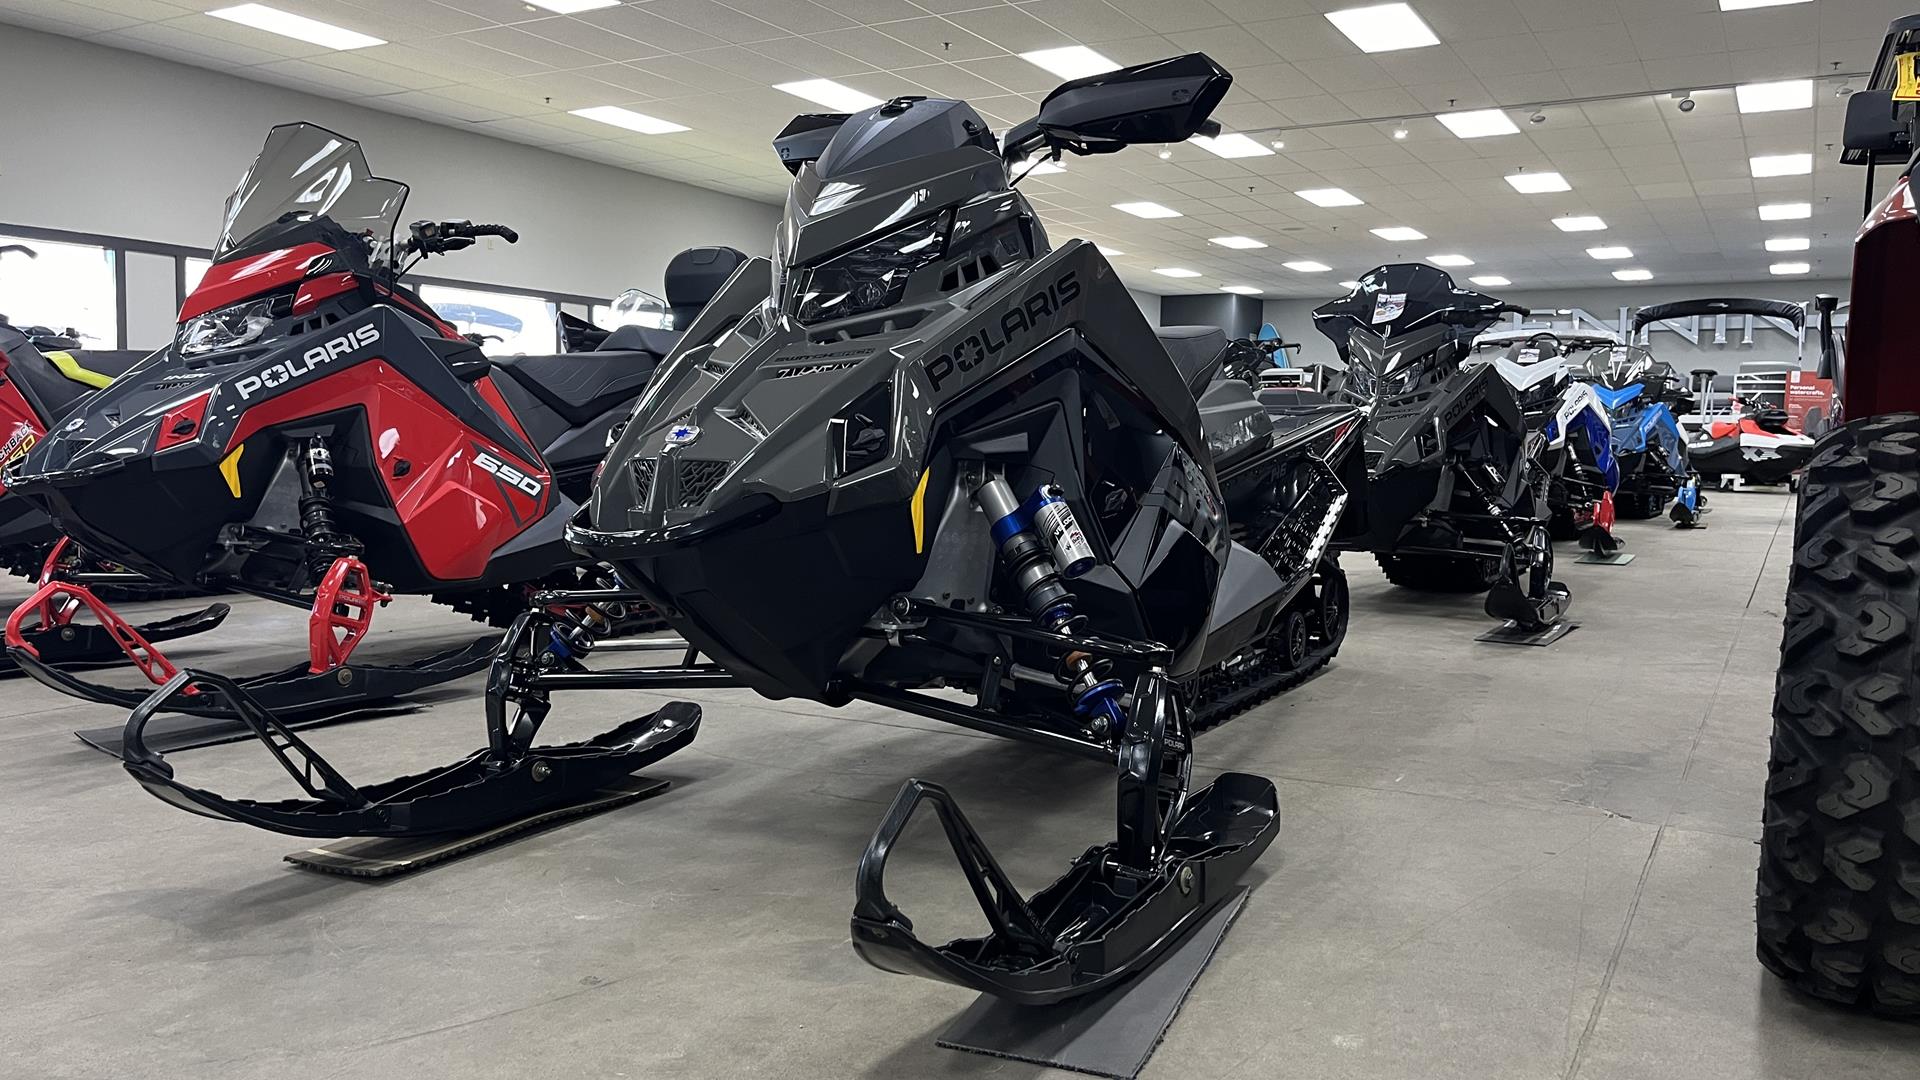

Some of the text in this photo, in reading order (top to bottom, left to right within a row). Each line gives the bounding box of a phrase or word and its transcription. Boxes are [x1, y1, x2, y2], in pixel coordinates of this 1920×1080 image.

[924, 270, 1081, 393] POLARIS
[234, 322, 381, 401] POLARIS
[1444, 375, 1490, 426] POLARIS
[473, 452, 543, 496] 650
[1164, 738, 1185, 751] POLARIS
